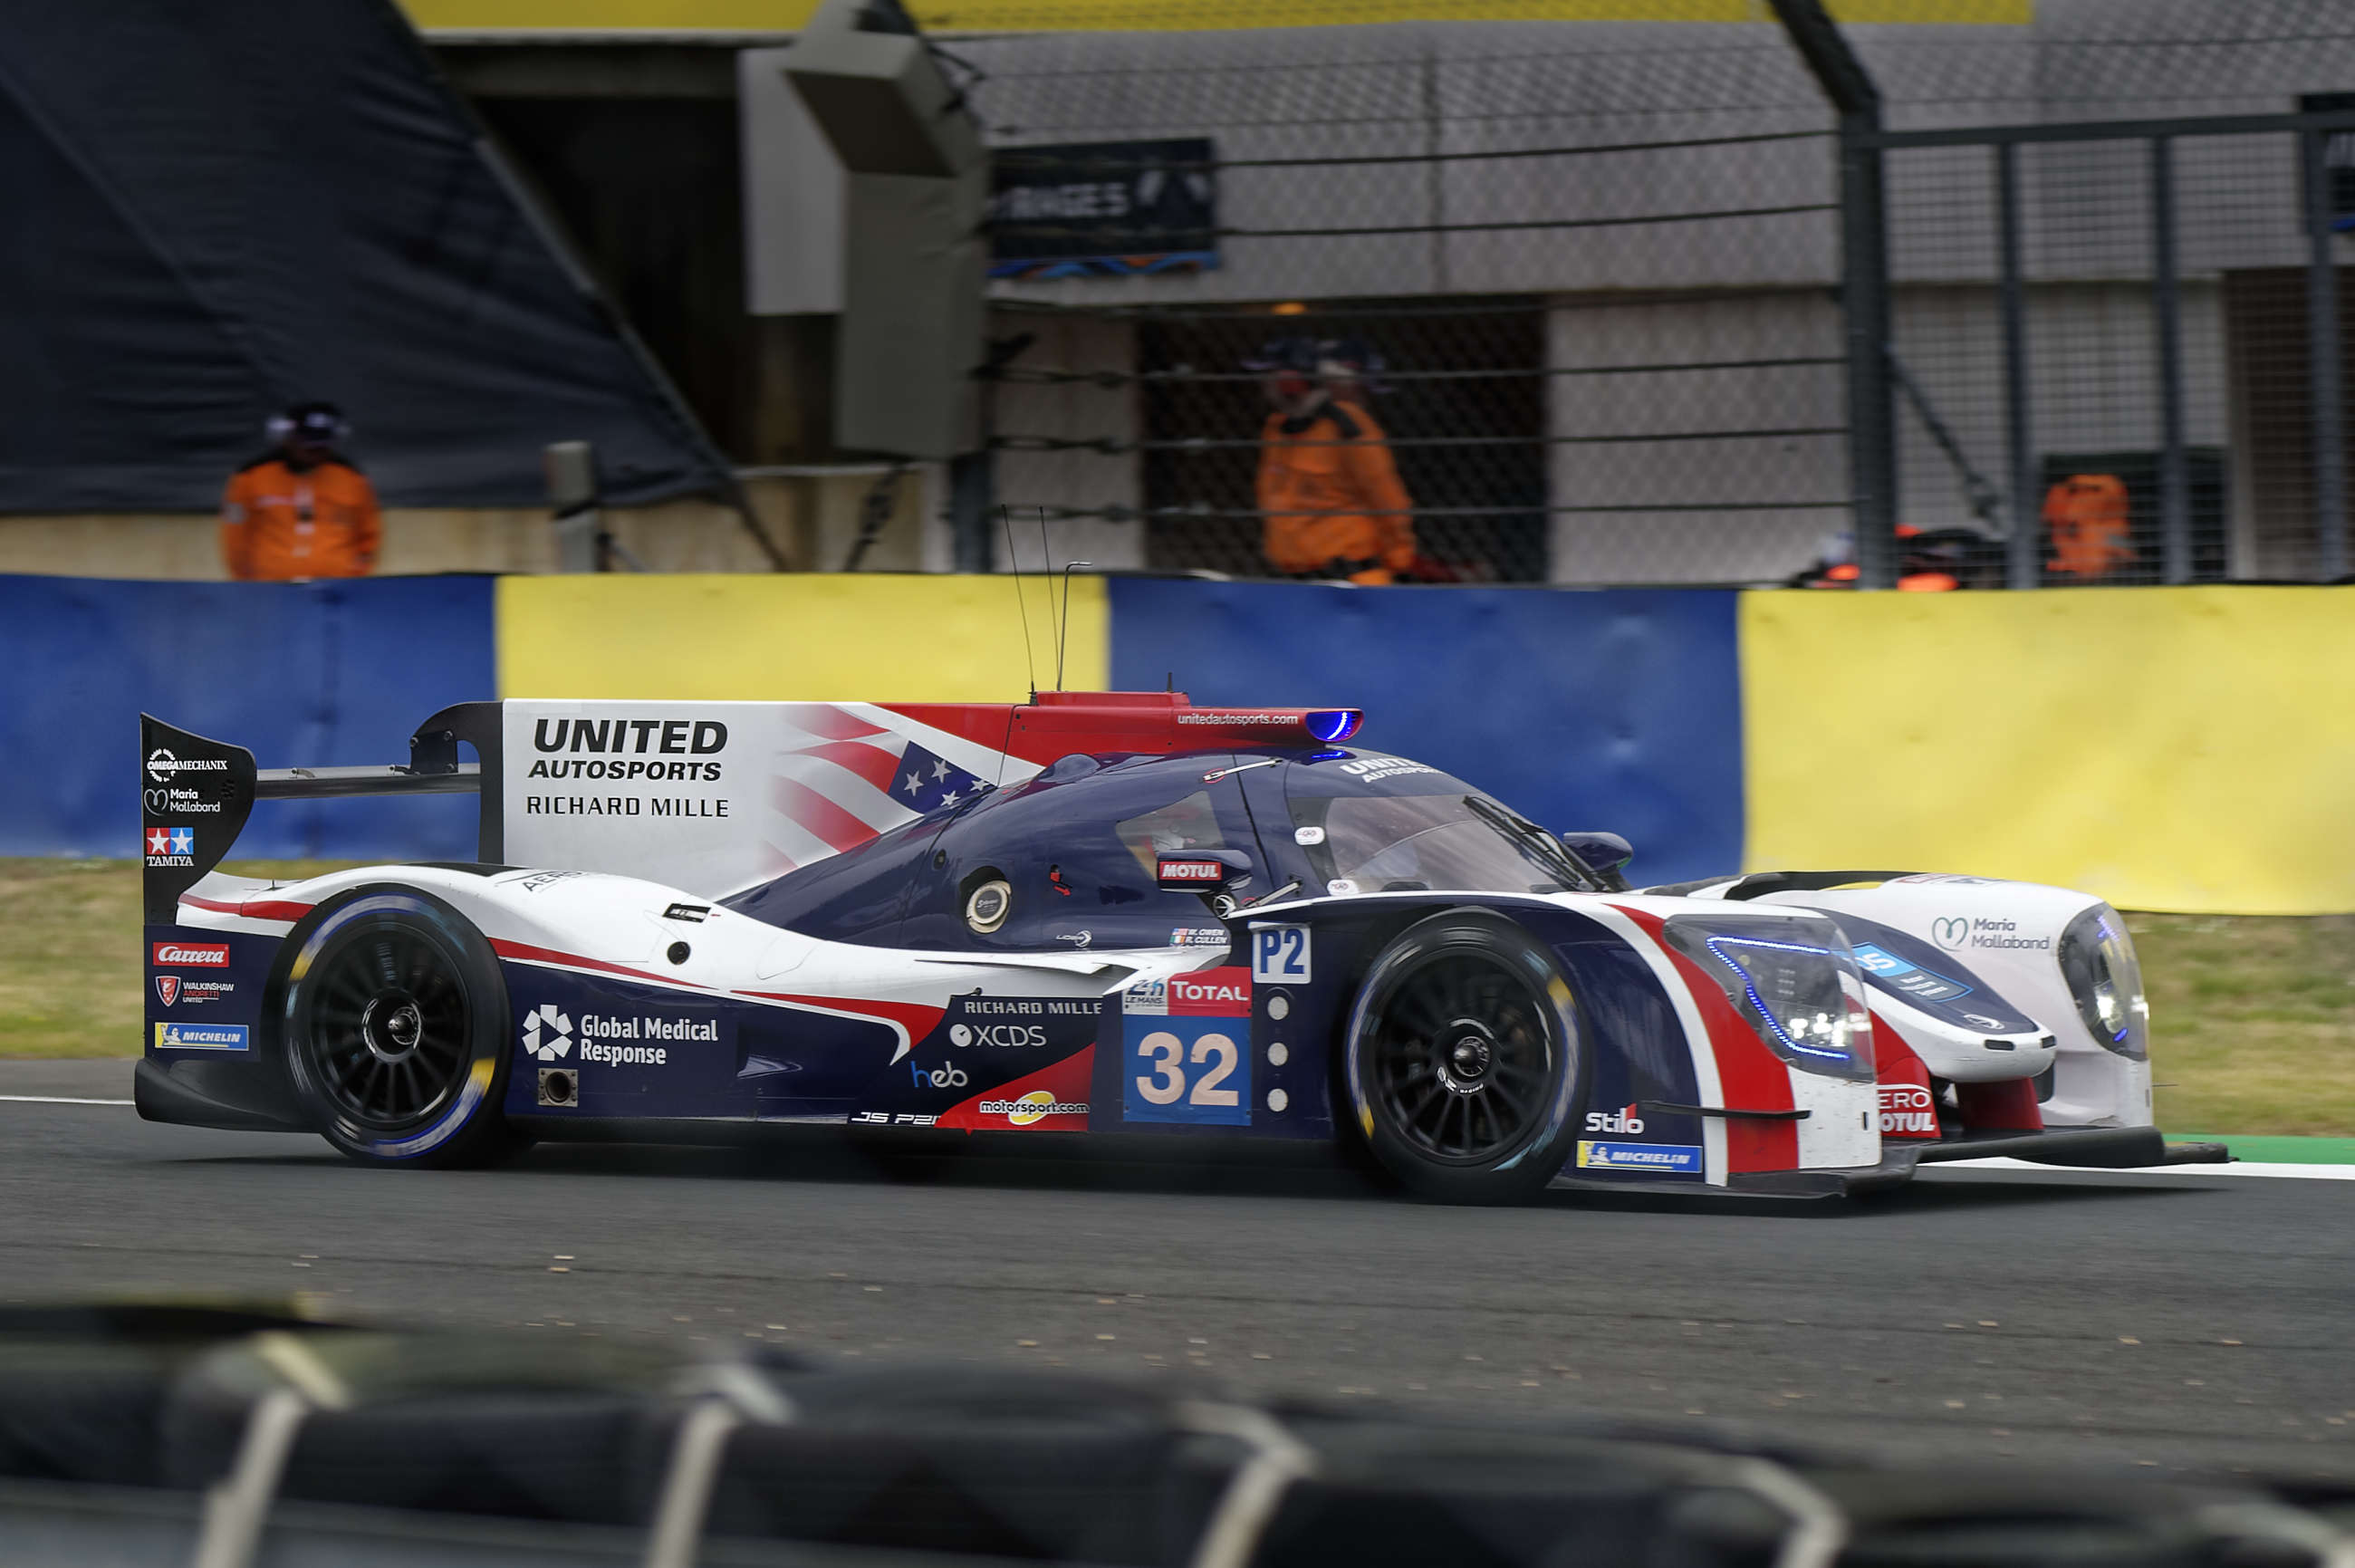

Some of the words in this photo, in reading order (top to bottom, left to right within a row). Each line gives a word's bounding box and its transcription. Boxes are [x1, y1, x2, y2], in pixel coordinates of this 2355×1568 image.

[1178, 713, 1298, 726] unitedautosports.com
[533, 718, 728, 755] UNITED
[147, 760, 227, 771] OMEGAMECHANIX
[528, 759, 722, 782] AUTOSPORTS
[1339, 758, 1431, 774] UNIT
[169, 788, 198, 799] Maria
[169, 801, 221, 813] Mallaband
[527, 796, 640, 816] RICHARD
[651, 798, 728, 818] MILLE
[146, 855, 195, 867] TAMIYA
[1162, 864, 1218, 879] MOTUL
[1973, 918, 2016, 931] Maria
[1970, 934, 2051, 950] Mallaband
[158, 946, 226, 963] Carrera
[1260, 928, 1304, 974] P2
[183, 982, 234, 992] WALKINSHAW
[1171, 981, 1248, 1001] TOTAL
[965, 1001, 1043, 1015] RICHARD
[1048, 1002, 1102, 1015] MILLE
[581, 1015, 639, 1039] Global
[645, 1017, 718, 1042] Medical
[974, 1024, 1047, 1047] XCDS
[183, 1032, 241, 1043] MICHELIN
[580, 1039, 667, 1067] Response
[1136, 1032, 1239, 1106] 32
[980, 1099, 1090, 1117] motorsport.com
[1878, 1092, 1931, 1109] ERO
[1585, 1103, 1645, 1134] Stilo
[1879, 1112, 1936, 1132] OTUL
[1610, 1151, 1690, 1165] MICHELIN
